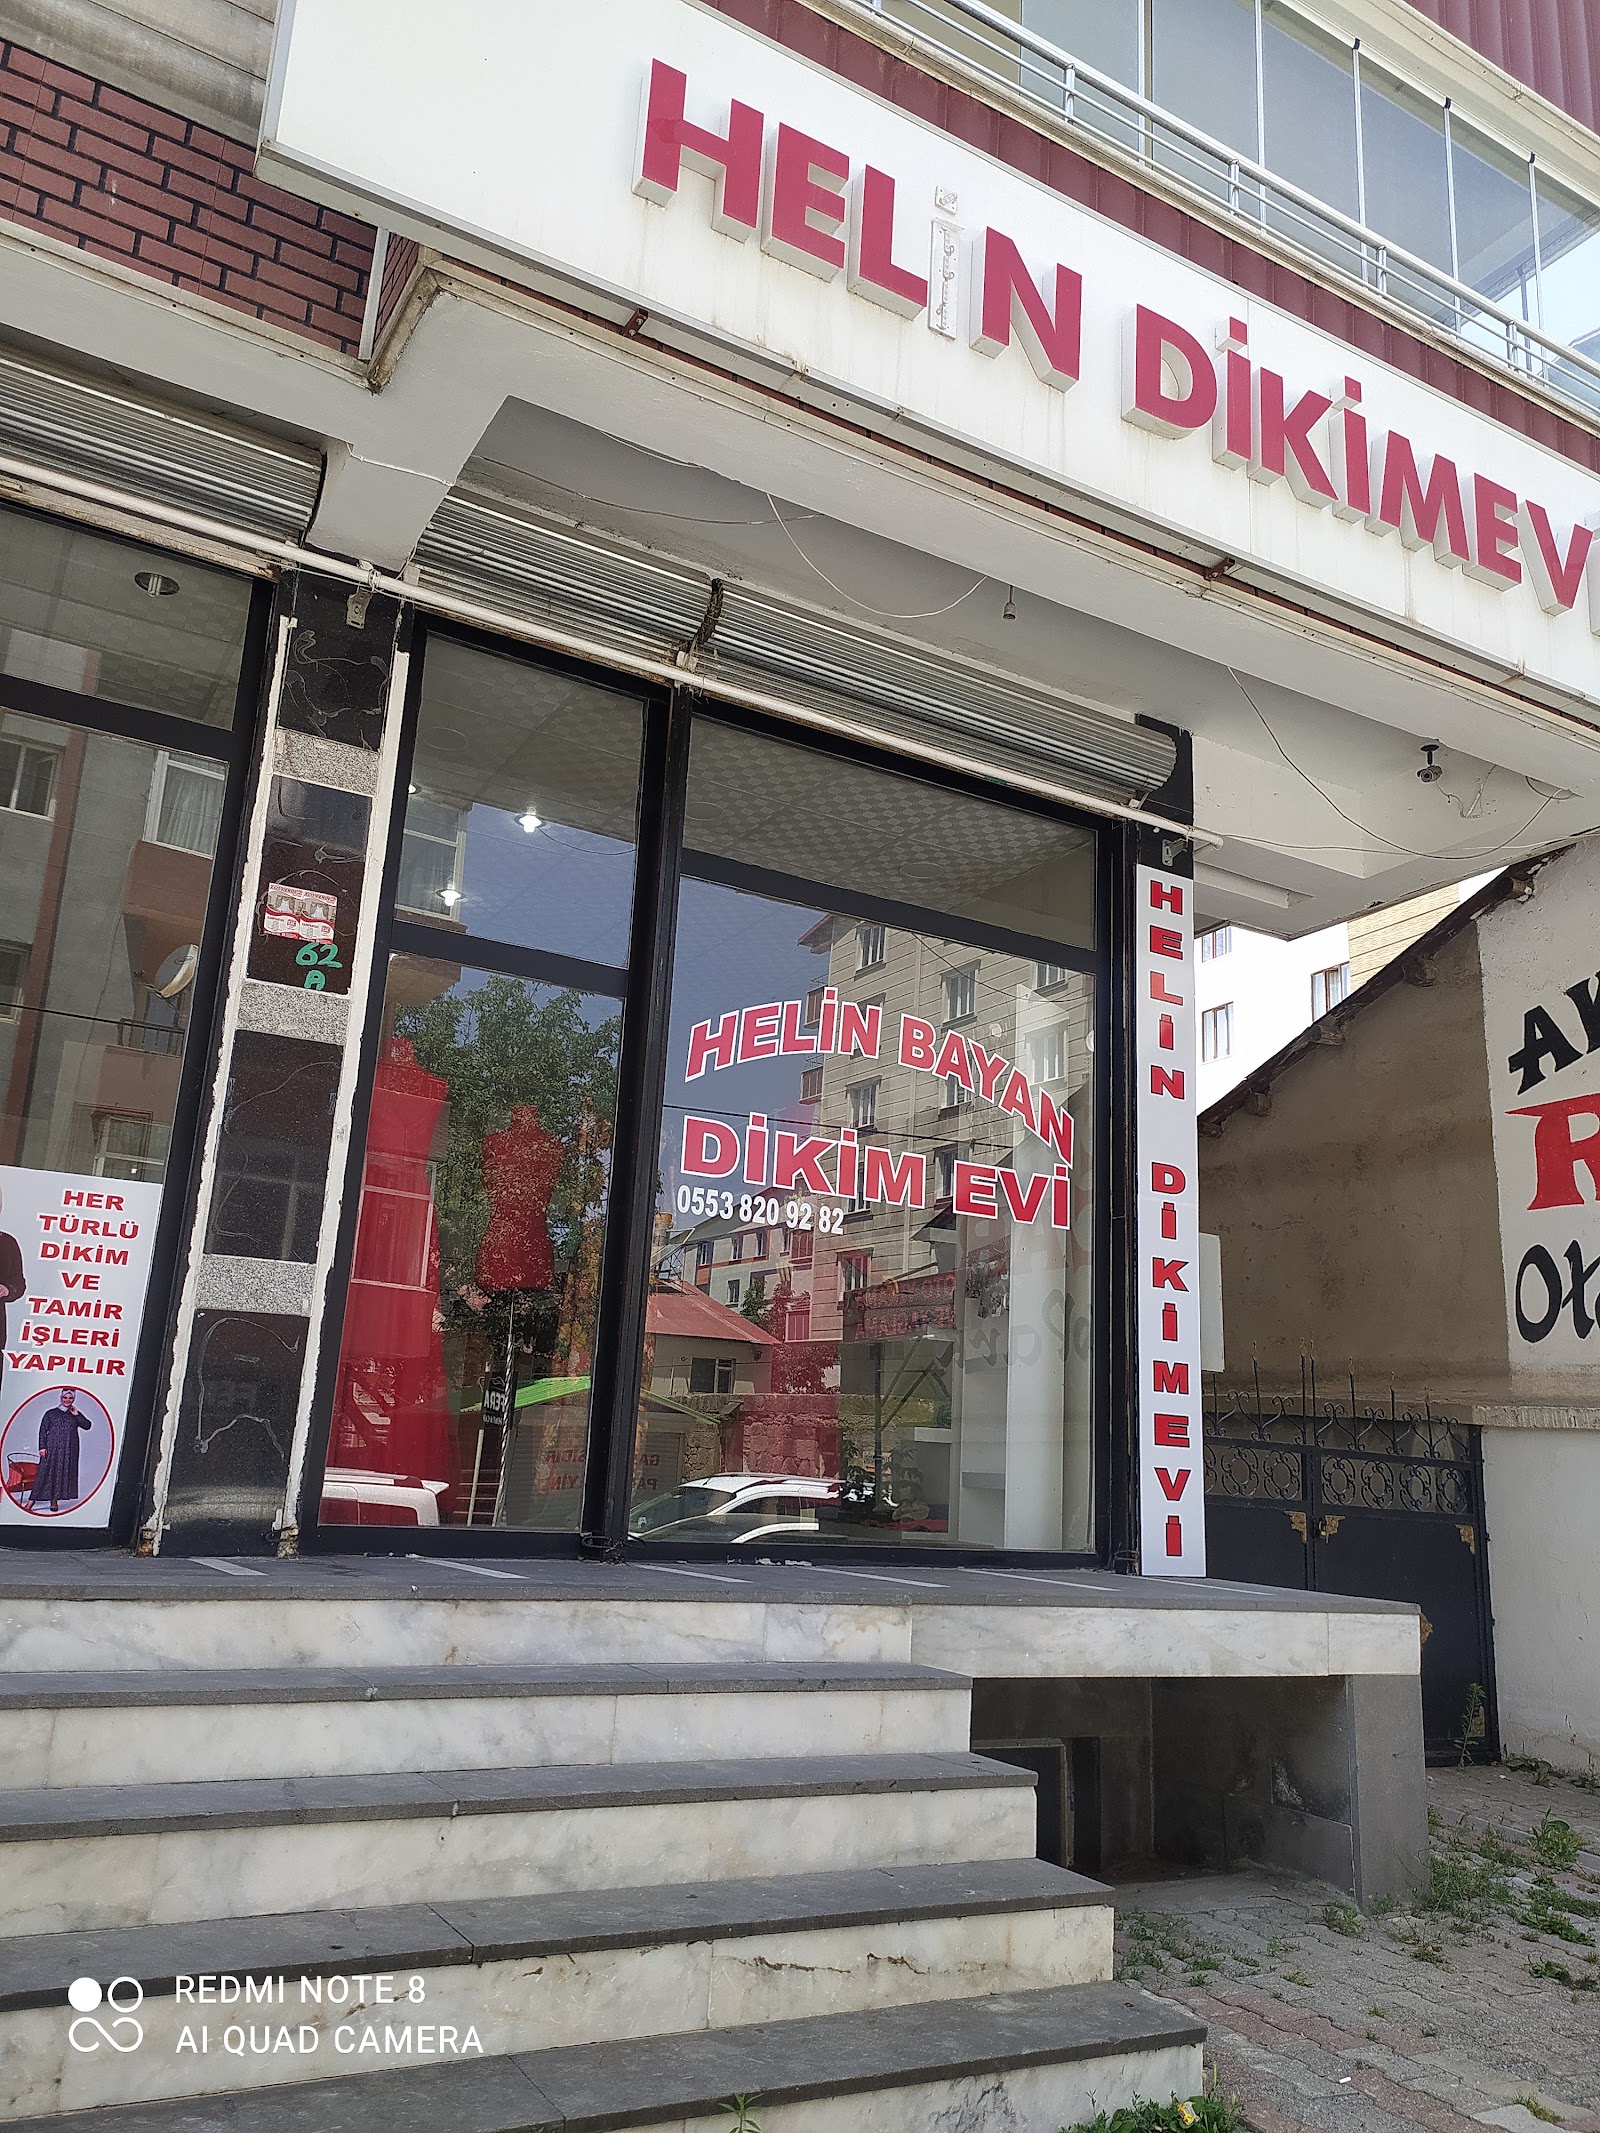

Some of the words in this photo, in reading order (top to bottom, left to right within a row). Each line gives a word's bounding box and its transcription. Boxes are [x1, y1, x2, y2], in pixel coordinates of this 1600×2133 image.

[1123, 303, 1600, 635] DİKİMEV
[295, 942, 343, 969] 62
[303, 969, 326, 991] A
[1150, 879, 1185, 1101] HELİN
[685, 986, 883, 1083] HELİN
[897, 1012, 1075, 1169] BAYAN
[680, 1111, 927, 1209] DİKİM
[952, 1158, 1071, 1230] EVİ
[62, 1189, 125, 1211] HER
[677, 1184, 734, 1220] 0553
[739, 1194, 779, 1226] 820
[786, 1200, 814, 1231] 92
[818, 1205, 844, 1234] 82
[38, 1214, 140, 1239] TÜRLÜ
[39, 1243, 129, 1266] DİKİM
[60, 1271, 101, 1291] VE
[27, 1297, 123, 1321] TAMİR
[20, 1322, 120, 1348] İŞLERİ
[6, 1351, 126, 1376] YAPILIR
